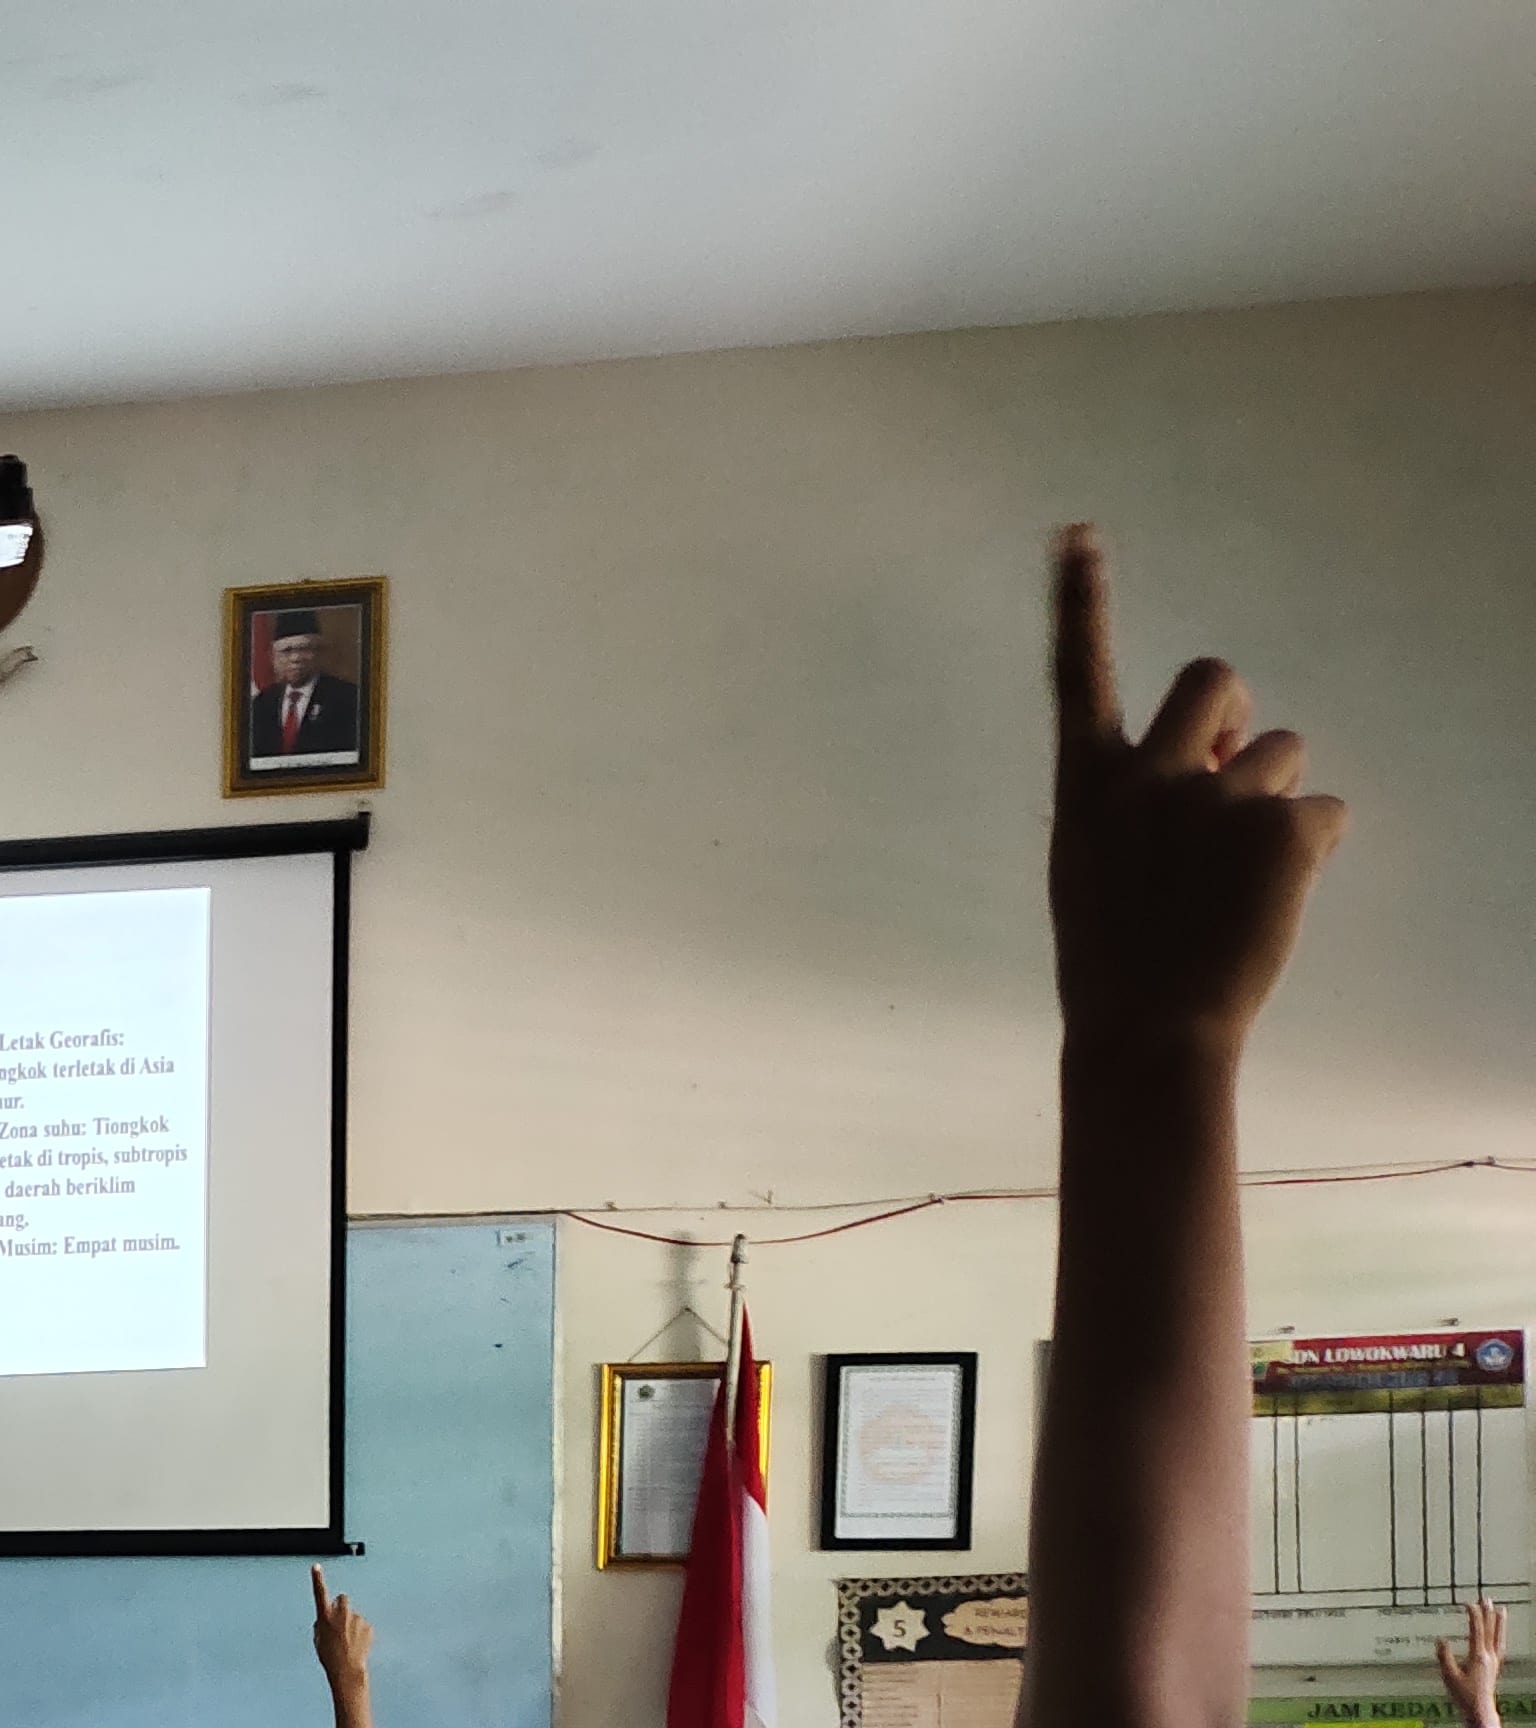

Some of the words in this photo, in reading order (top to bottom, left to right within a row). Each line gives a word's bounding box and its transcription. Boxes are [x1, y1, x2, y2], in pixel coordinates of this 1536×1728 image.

[49, 1028, 126, 1050] Georafis:
[52, 1058, 116, 1079] terletak
[119, 1057, 136, 1076] di
[139, 1055, 176, 1075] Asia
[43, 1118, 88, 1138] suhu:
[92, 1114, 171, 1139] Tiongkok
[37, 1148, 53, 1167] di
[58, 1146, 110, 1171] tropis,
[113, 1143, 188, 1168] subtropis
[4, 1178, 61, 1199] daerah
[66, 1175, 136, 1196] beriklim
[63, 1235, 117, 1259] Empat
[123, 1232, 181, 1252] musim.
[892, 1619, 908, 1638] 5
[1307, 1702, 1360, 1719] JAM
